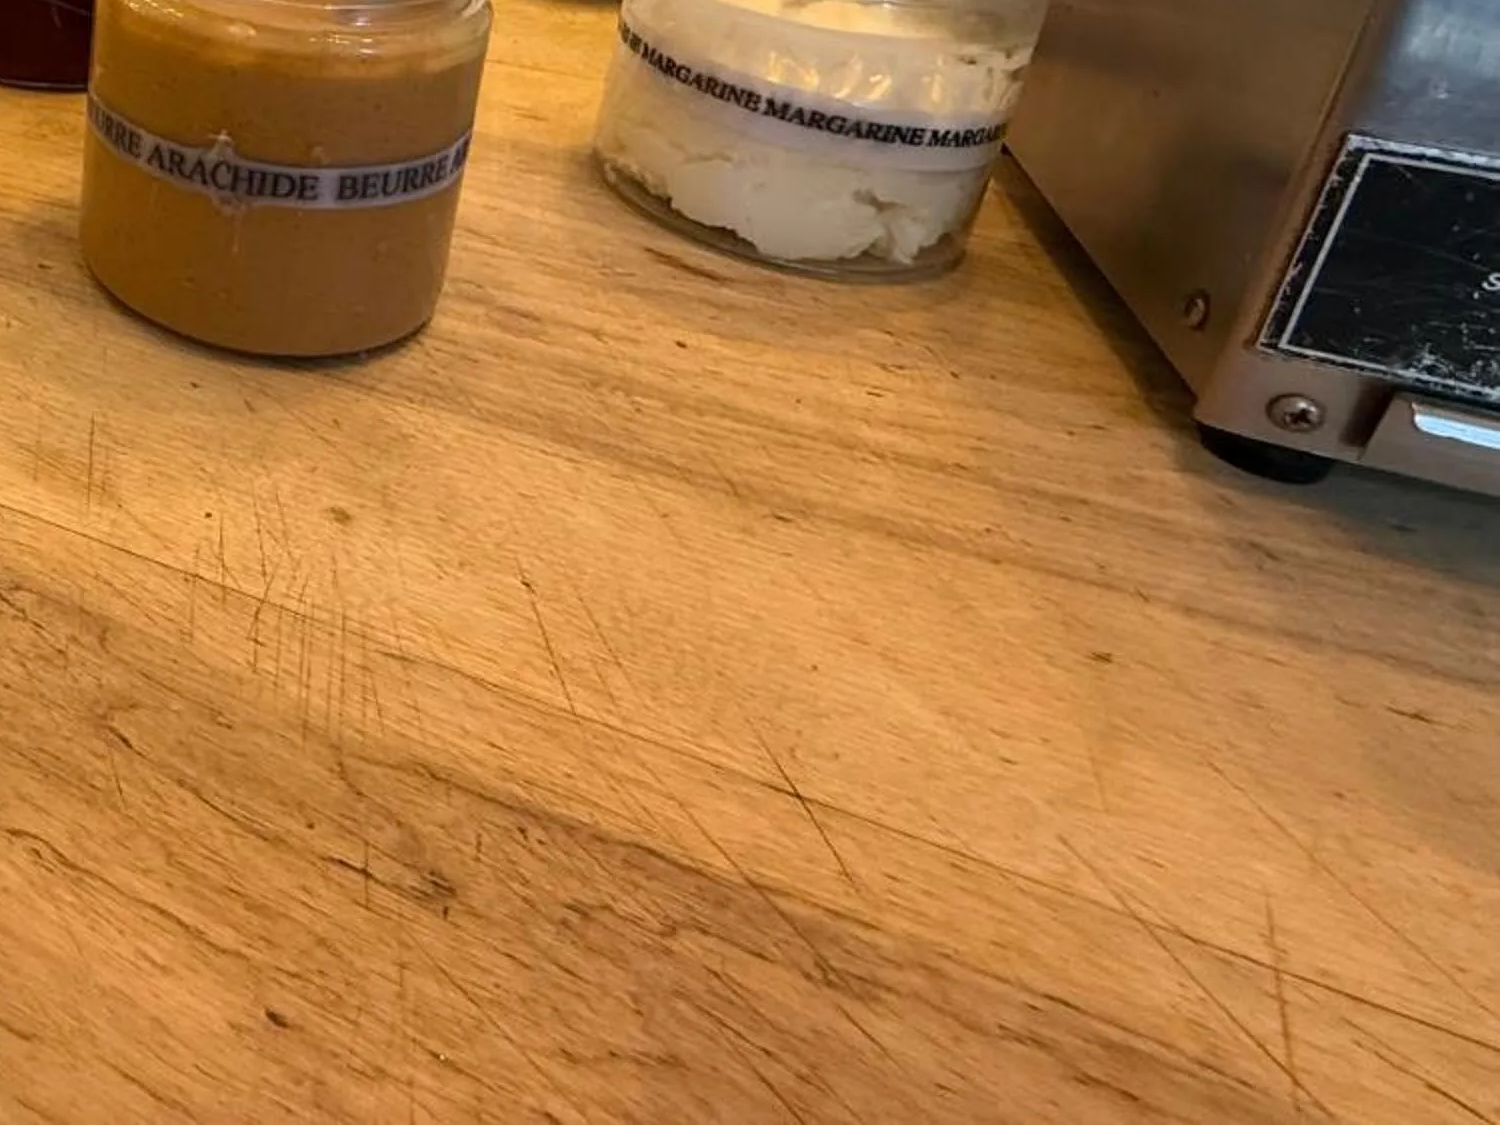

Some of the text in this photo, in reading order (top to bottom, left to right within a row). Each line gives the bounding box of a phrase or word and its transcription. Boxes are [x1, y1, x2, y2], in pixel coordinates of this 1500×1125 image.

[641, 42, 760, 112] MARGARINE
[757, 97, 927, 146] MARGARINE
[95, 105, 142, 159] URRE
[147, 144, 319, 201] ARACHIDE
[335, 155, 449, 202] BEURRE
